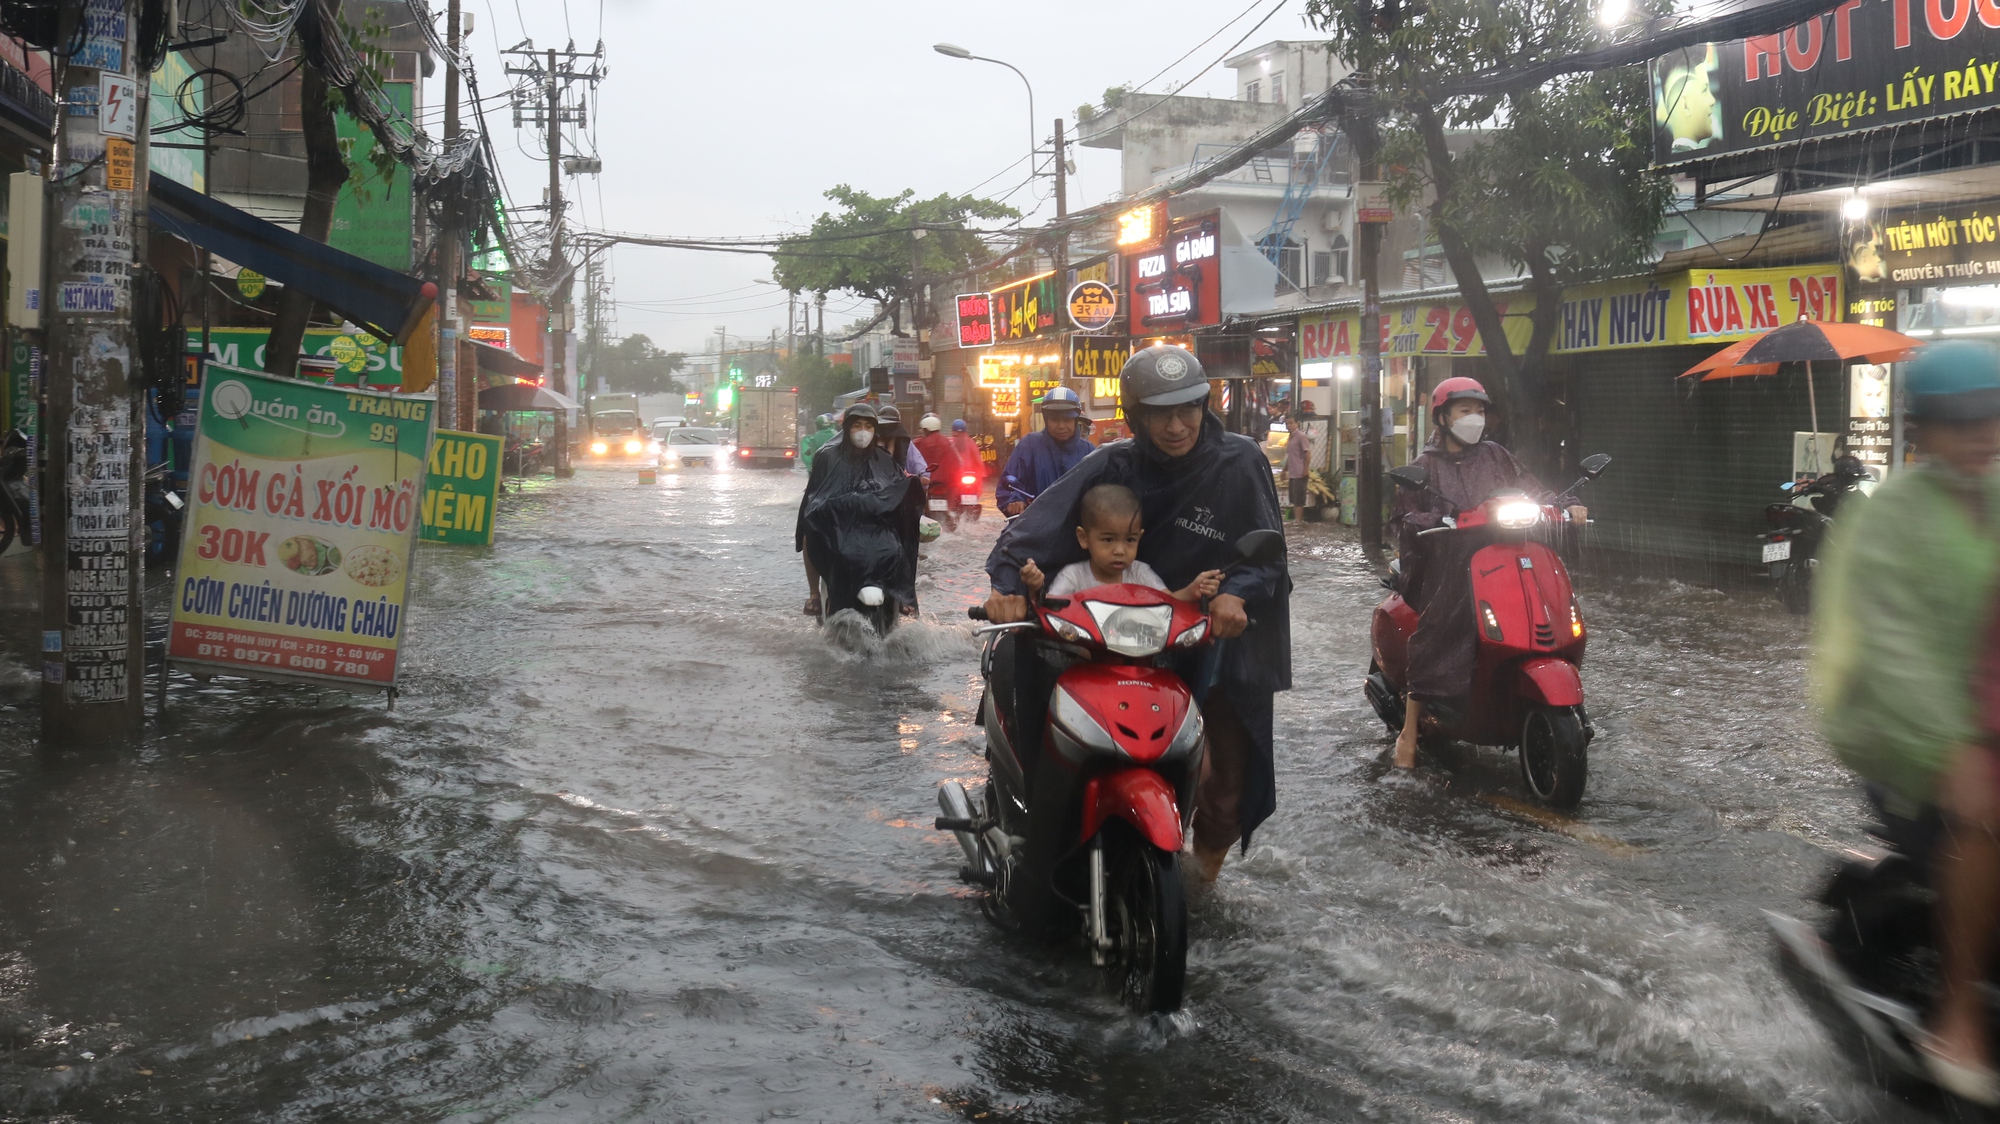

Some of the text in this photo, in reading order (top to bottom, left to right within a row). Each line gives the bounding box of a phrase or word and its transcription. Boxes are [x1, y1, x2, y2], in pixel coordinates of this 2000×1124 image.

[1743, 106, 1799, 141] Đặc
[1809, 88, 1877, 128] Biệt:
[1886, 66, 1935, 112] LẤY
[1176, 231, 1215, 263] GÀ RÁN
[1886, 211, 1996, 257] TIỆM HỚT TÓC
[1138, 254, 1166, 279] PIZZA
[1892, 264, 1944, 282] CHUYÊN
[1946, 260, 1983, 278] THỰC
[241, 284, 262, 295] 60%
[1148, 288, 1168, 316] TRÀ
[959, 295, 988, 317] BÚN
[1609, 282, 1670, 345] NHỚT
[1688, 273, 1838, 335] RỬA XE 297
[1850, 297, 1895, 314] HỚT TÓC
[961, 319, 990, 345] ĐẬU
[1303, 312, 1348, 360] RỬA
[333, 350, 356, 361] 60%
[1075, 338, 1099, 376] CẮT
[306, 404, 338, 426] ăn
[346, 394, 426, 422] TRANG
[369, 423, 397, 443] 99
[1850, 420, 1875, 433] Chuyên
[1876, 435, 1892, 446] Nam
[427, 438, 487, 480] KHO
[198, 459, 415, 534] CƠM GÀ XỐI MỠ
[421, 483, 486, 536] NỆM
[1175, 518, 1225, 541] PRUDENTIAL
[197, 524, 270, 567] 30K
[182, 576, 400, 640] CƠM CHIÊN DƯƠNG CHÂU
[185, 628, 203, 639] ĐC:
[205, 631, 224, 641] 266
[227, 633, 255, 645] PHAN
[257, 636, 278, 648] HUY
[280, 638, 297, 651] ÍCH
[306, 643, 327, 654] P.12
[349, 648, 362, 659] GÒ
[365, 650, 385, 661] VẤP
[198, 643, 369, 676] ĐT: 0971 600 780
[1117, 680, 1153, 688] HONDA
